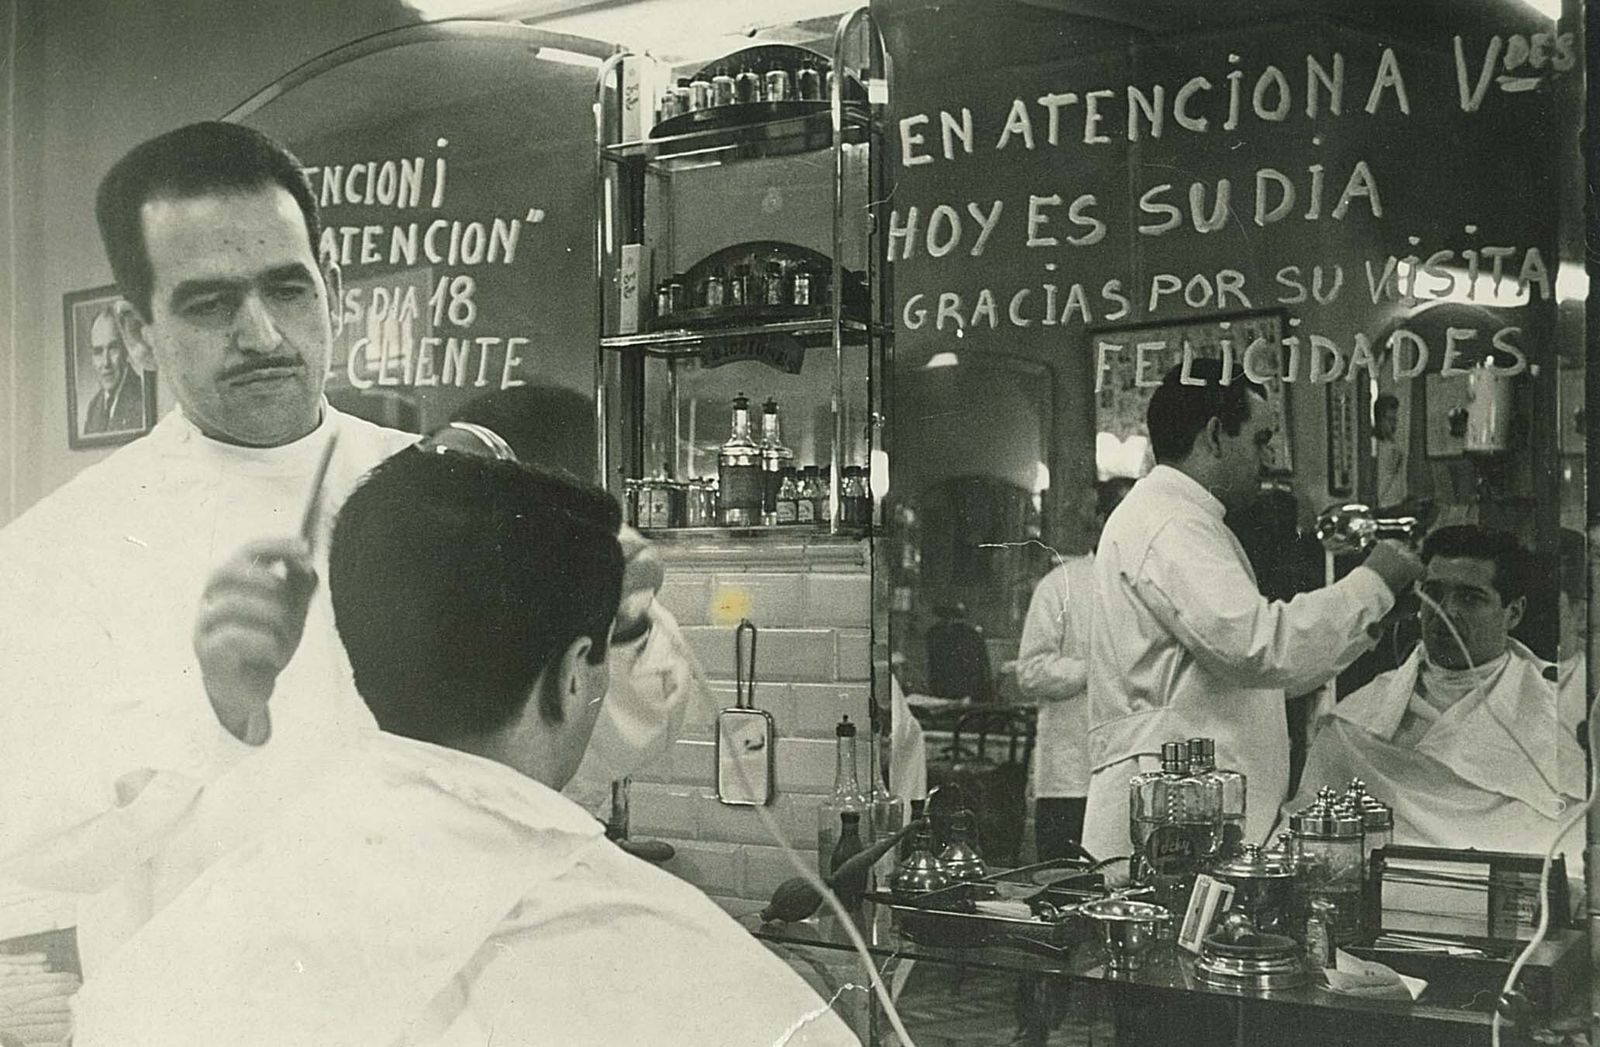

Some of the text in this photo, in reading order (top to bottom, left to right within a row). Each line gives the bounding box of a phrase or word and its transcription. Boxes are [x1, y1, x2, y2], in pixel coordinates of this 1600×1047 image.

[899, 107, 974, 167] EN
[1365, 48, 1411, 115] A
[886, 200, 1003, 262] HOY
[1026, 193, 1106, 247] ES
[1138, 177, 1231, 237] SU
[429, 275, 477, 328] 18
[1149, 268, 1252, 312] POR
[1275, 264, 1343, 305] SU
[348, 337, 531, 390] CLIENTE
